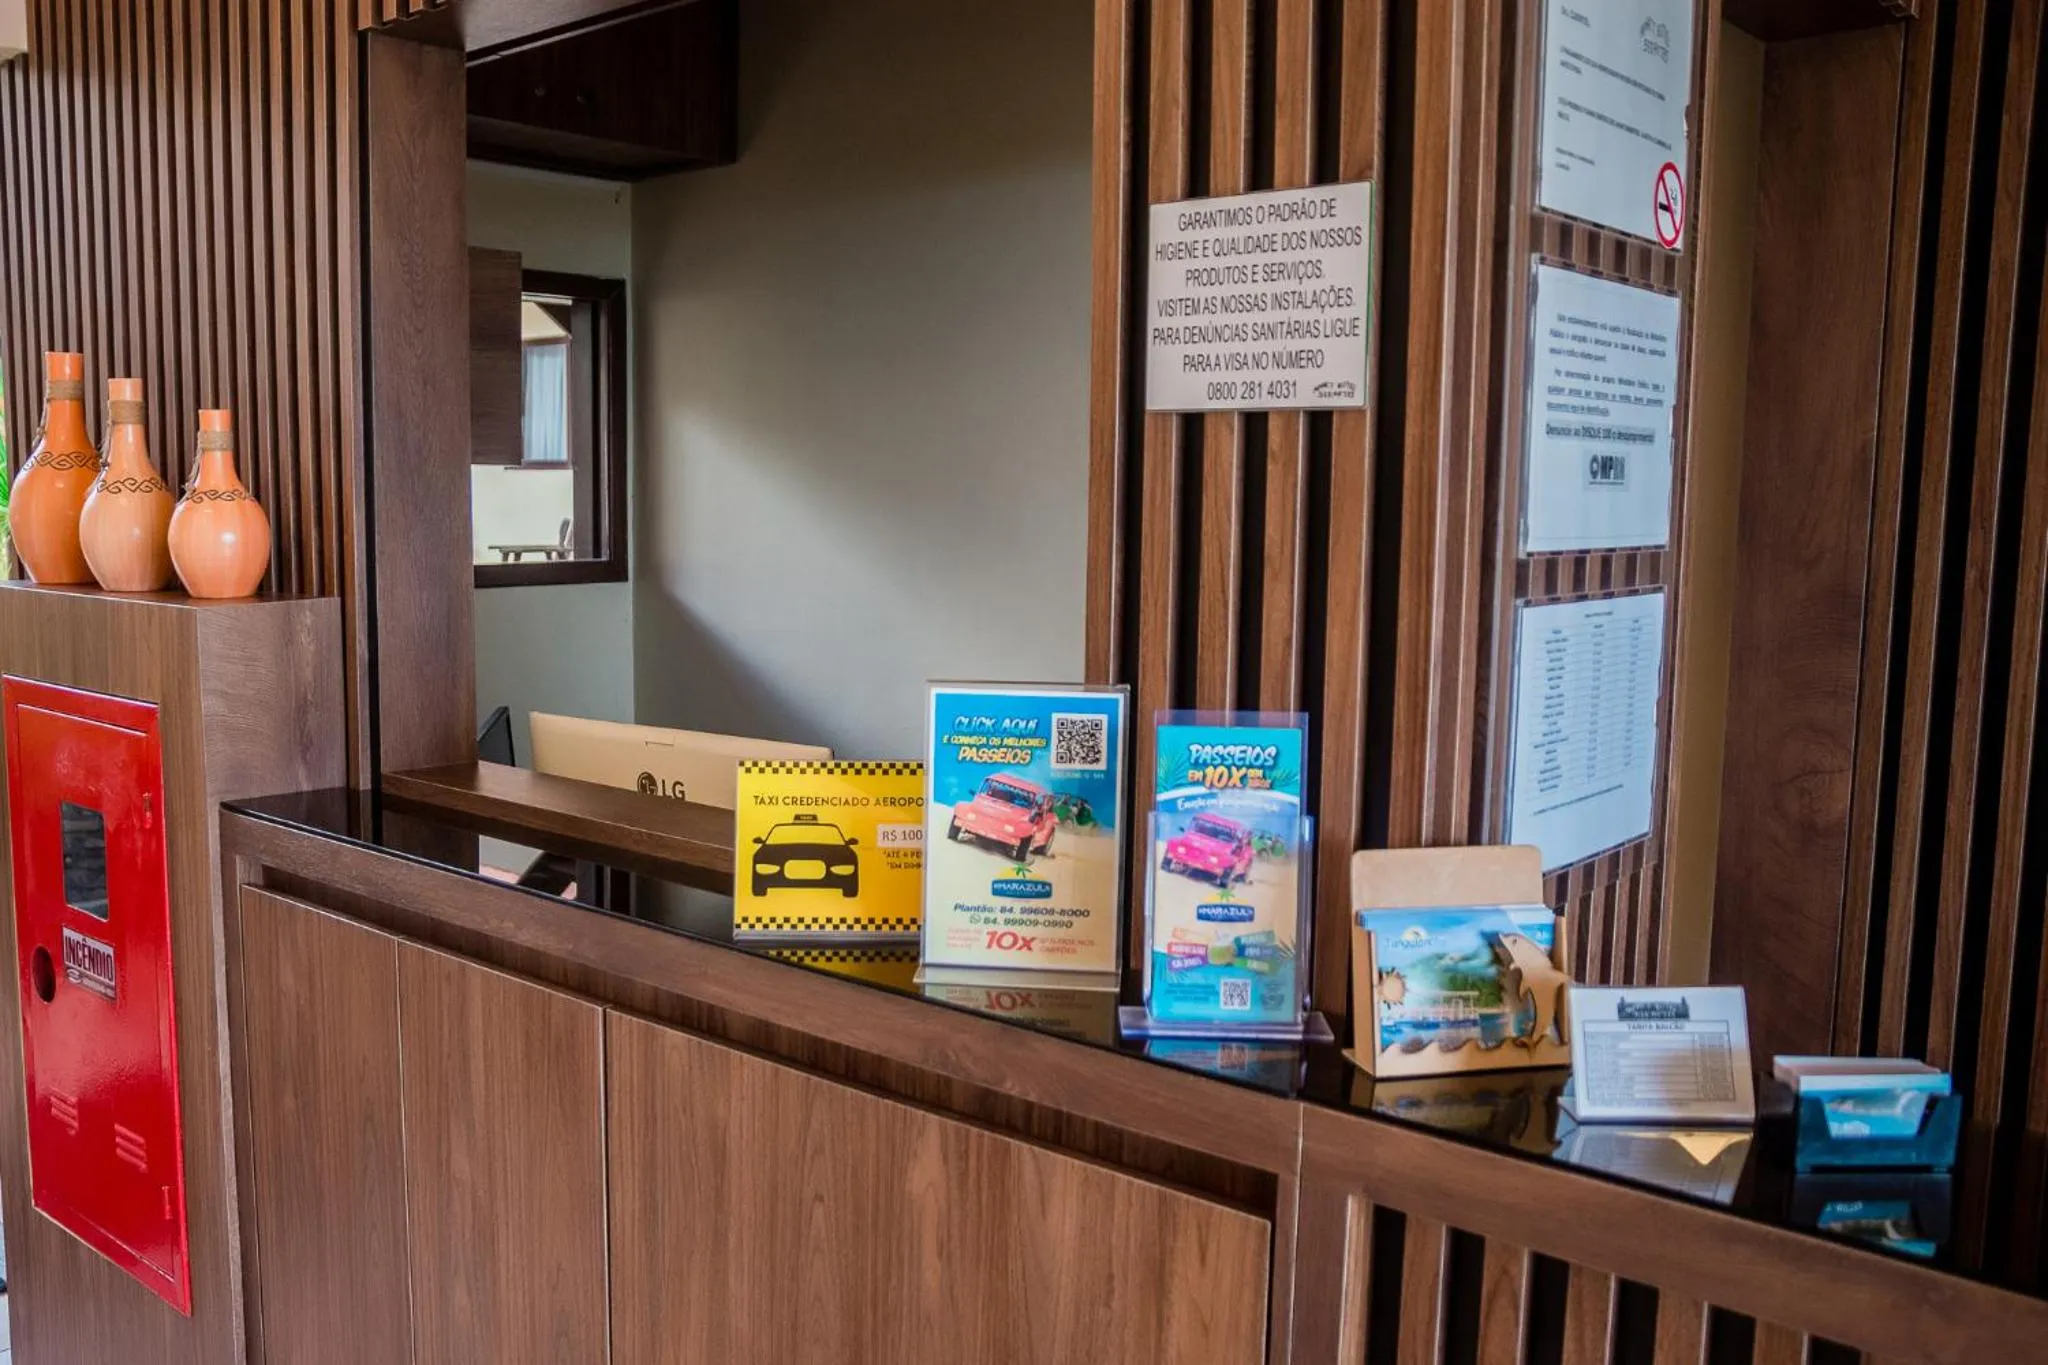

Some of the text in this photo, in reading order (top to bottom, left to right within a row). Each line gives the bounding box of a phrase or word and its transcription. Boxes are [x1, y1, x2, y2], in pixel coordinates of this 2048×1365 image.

[1178, 197, 1337, 232] GARANTIMOS O PADRÃO DE
[1155, 225, 1362, 261] HIGIENE E QUALIDADE DOS NOSSOS
[1185, 259, 1325, 288] PRODUTOS E SERVIÇOS.
[1158, 285, 1356, 317] VISITEM AS NOSSAS INSTALAÇÕES.
[1153, 316, 1361, 346] PARA DENÚNCIAS SANITÁRIAS LIGUE
[1183, 346, 1324, 373] PARA A VISA NO NÚMERO
[1207, 381, 1238, 400] 0800
[1240, 380, 1262, 400] 281
[1267, 379, 1298, 400] 4031
[954, 716, 1038, 733] CLICK AQUI
[958, 746, 1032, 765] PASSEIOS
[1188, 743, 1278, 766] PASSEIOS
[1205, 765, 1248, 788] 10X
[661, 779, 686, 801] LG
[782, 796, 870, 807] CREDENCIADO
[874, 796, 928, 808] AEROPO
[882, 829, 923, 842] R$ 100
[953, 903, 997, 915] Plantão:
[65, 936, 114, 982] INCÊNDIO
